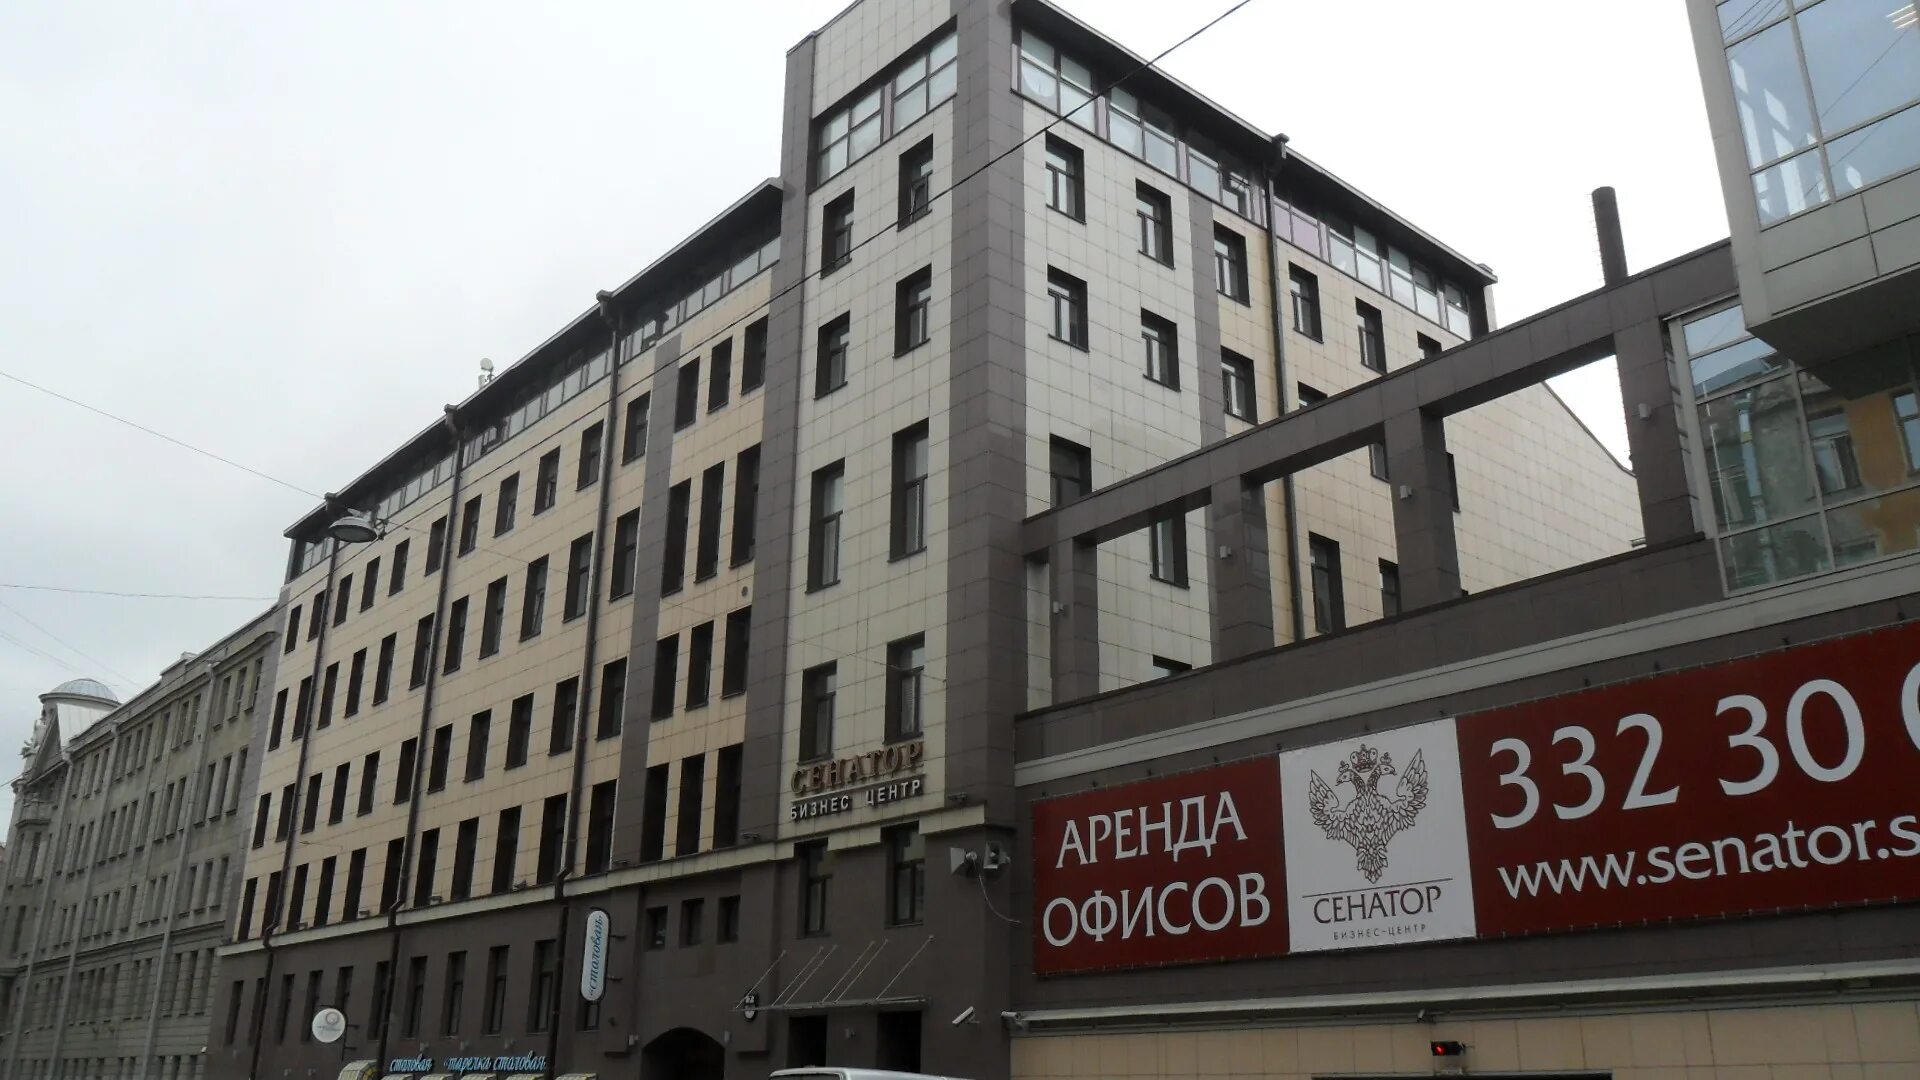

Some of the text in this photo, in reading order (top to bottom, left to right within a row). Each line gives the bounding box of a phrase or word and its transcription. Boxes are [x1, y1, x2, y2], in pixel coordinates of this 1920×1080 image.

[791, 741, 924, 795] СЕНАТОР
[1490, 713, 1680, 829] 332
[1715, 678, 1865, 796] 30
[790, 779, 921, 820] БИЗНЕС ЦЕНТР
[1055, 791, 1248, 869] АРЕНДА
[1042, 872, 1271, 947] ОФИСОВ
[1313, 885, 1441, 925] СЕНАТОР
[1333, 923, 1428, 941] БИЗНЕС-ЦЕНТР
